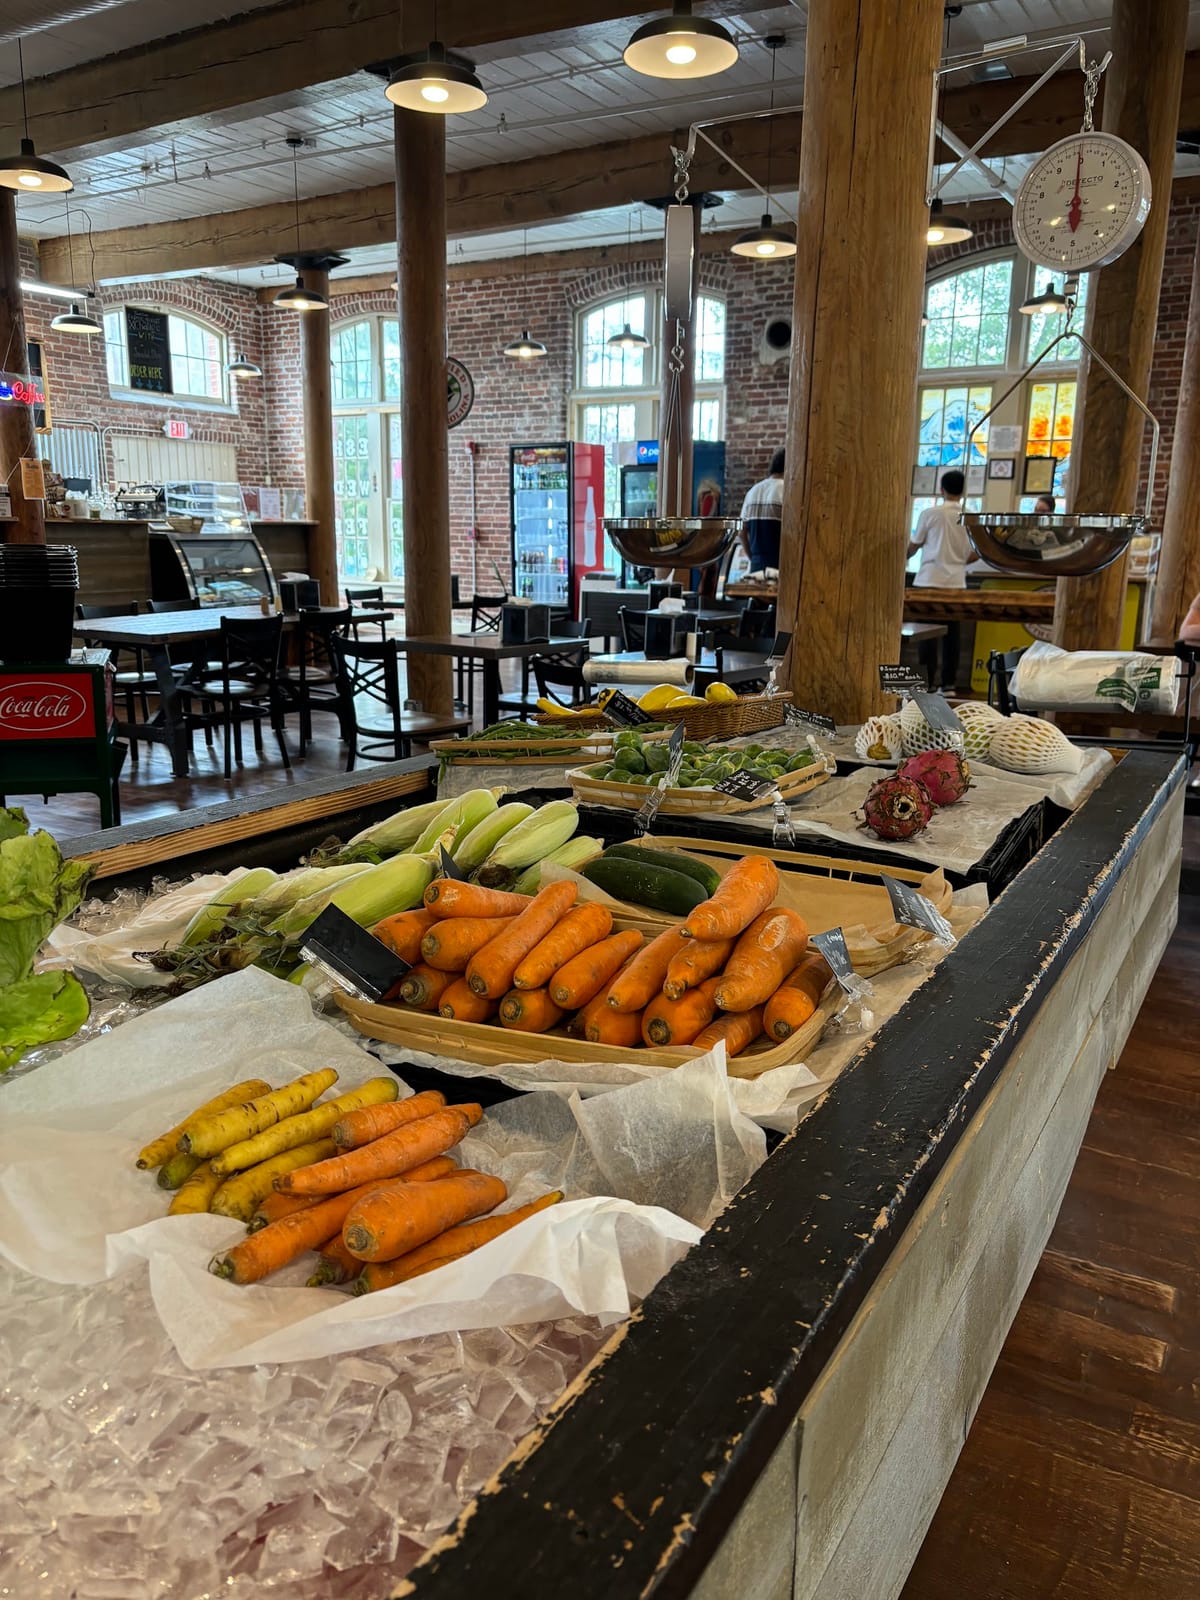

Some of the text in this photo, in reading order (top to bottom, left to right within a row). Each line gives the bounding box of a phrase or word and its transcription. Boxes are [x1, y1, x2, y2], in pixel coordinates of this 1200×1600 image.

[1066, 176, 1104, 186] DEECTO
[130, 364, 163, 380] ORDER HERE
[12, 381, 46, 405] Coffee
[171, 421, 186, 437] EXIT
[648, 448, 659, 457] pe
[0, 694, 72, 719] Coca-Cola
